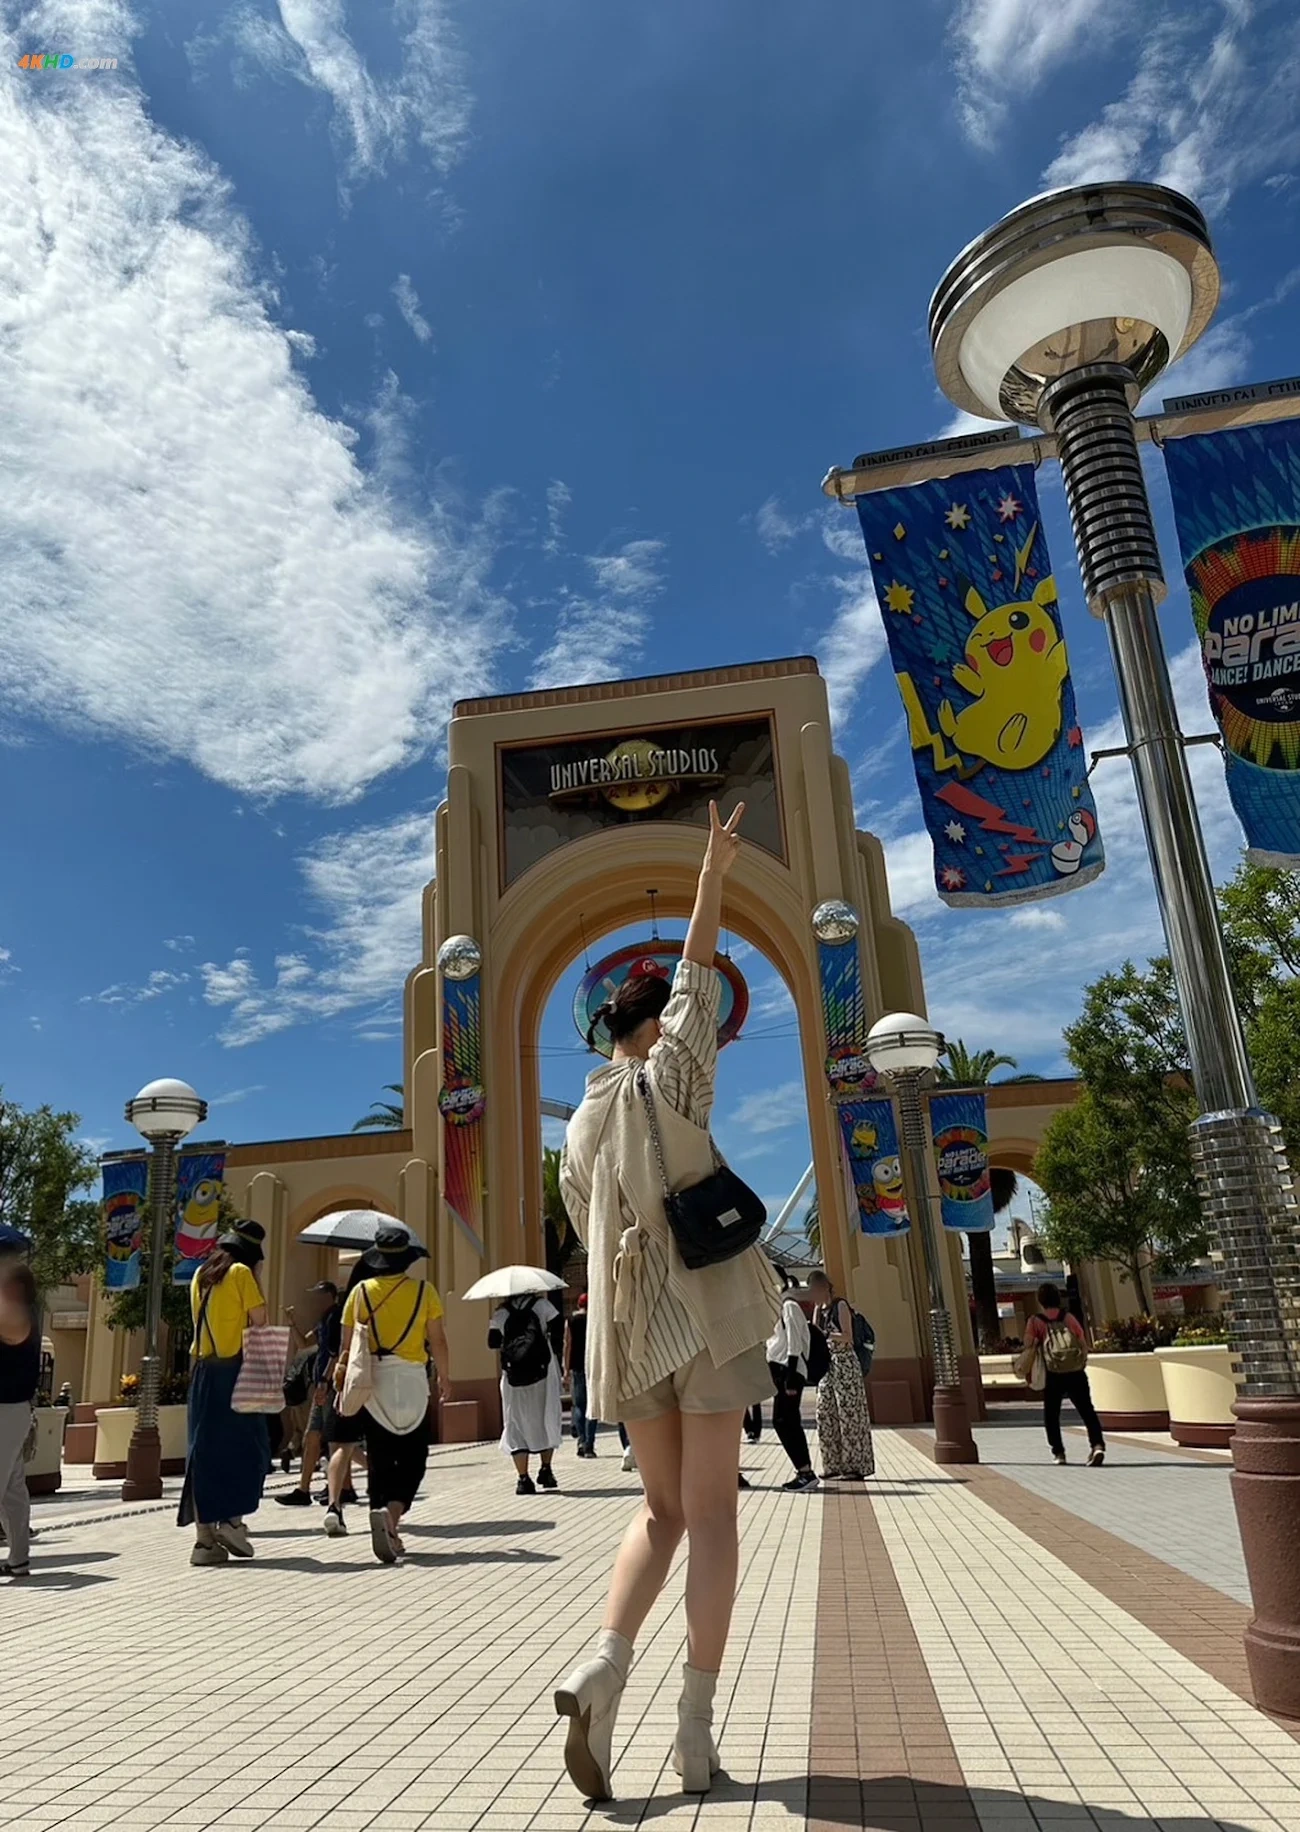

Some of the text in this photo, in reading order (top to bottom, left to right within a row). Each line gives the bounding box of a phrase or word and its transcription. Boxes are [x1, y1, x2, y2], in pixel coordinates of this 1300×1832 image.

[1224, 614, 1254, 637] NO
[550, 748, 719, 790] UNIVERSAL STUDIOS
